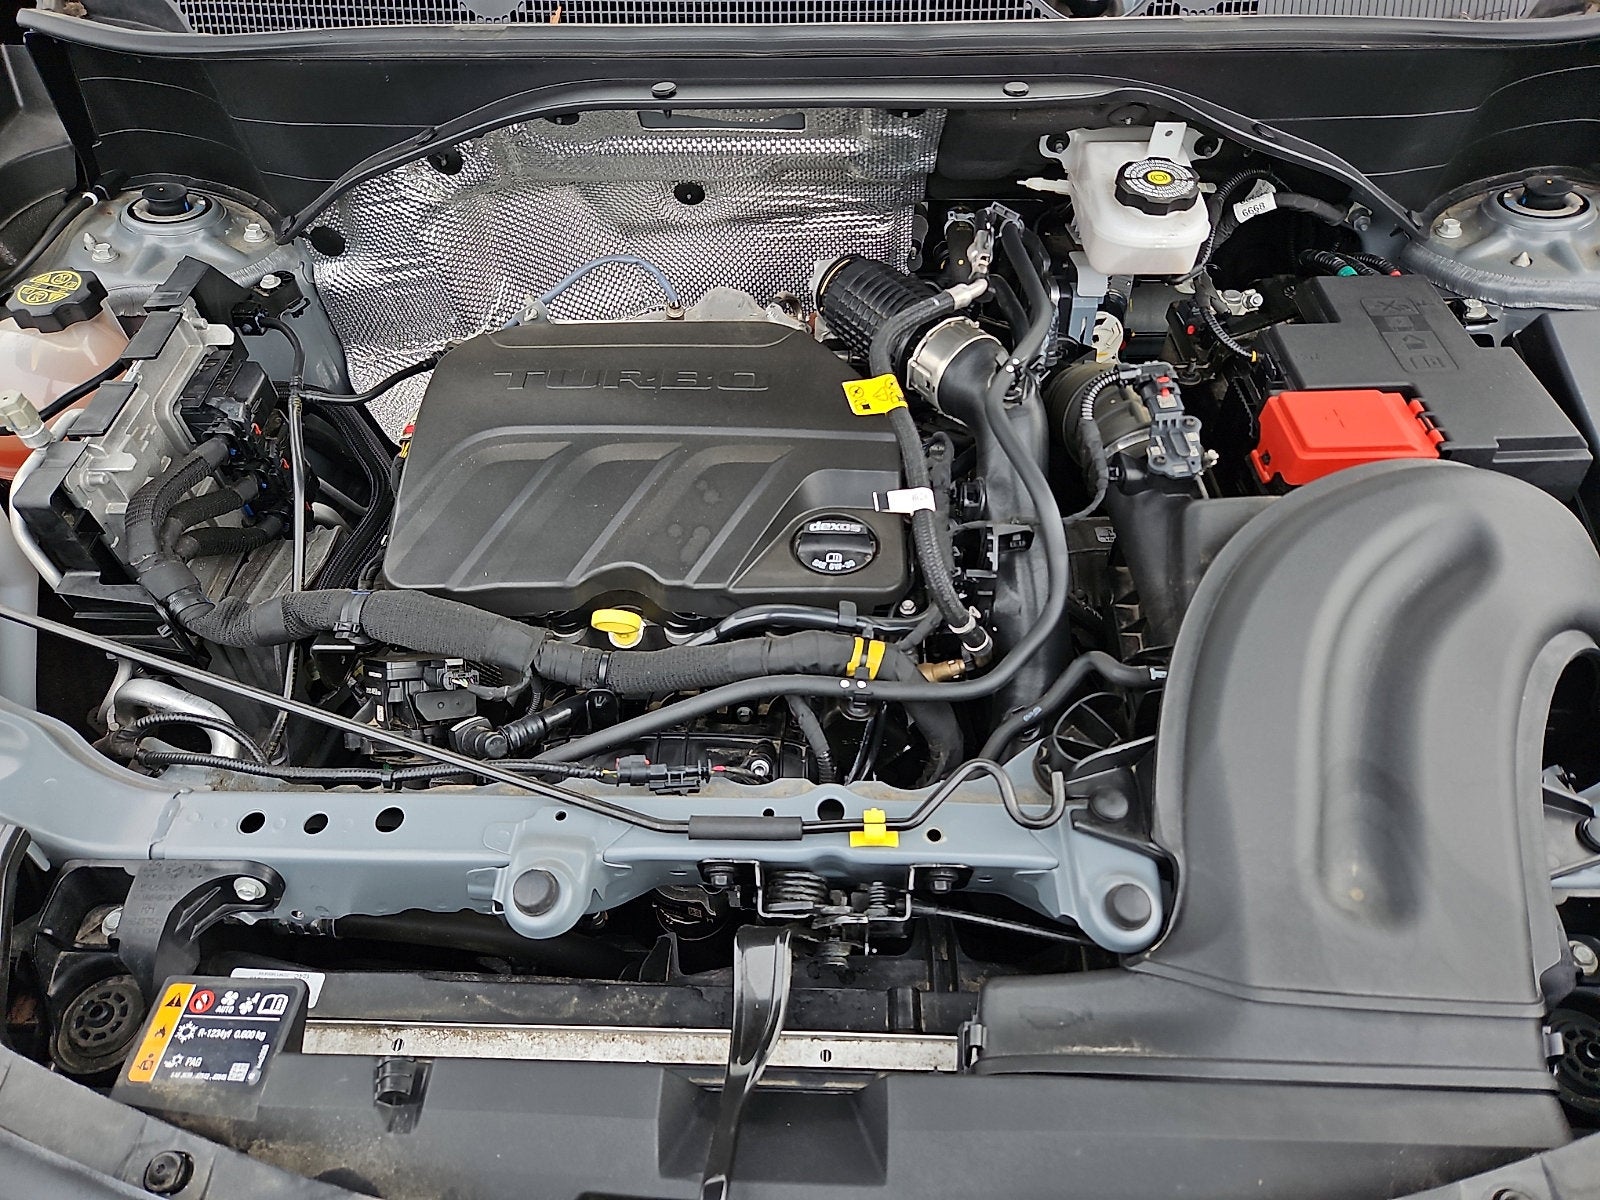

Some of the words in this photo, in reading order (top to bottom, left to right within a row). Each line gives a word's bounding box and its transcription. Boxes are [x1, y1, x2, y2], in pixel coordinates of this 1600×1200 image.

[493, 369, 769, 391] TURBO
[809, 521, 862, 533] dexos
[214, 1004, 235, 1014] AUTO
[256, 1030, 267, 1041] kg
